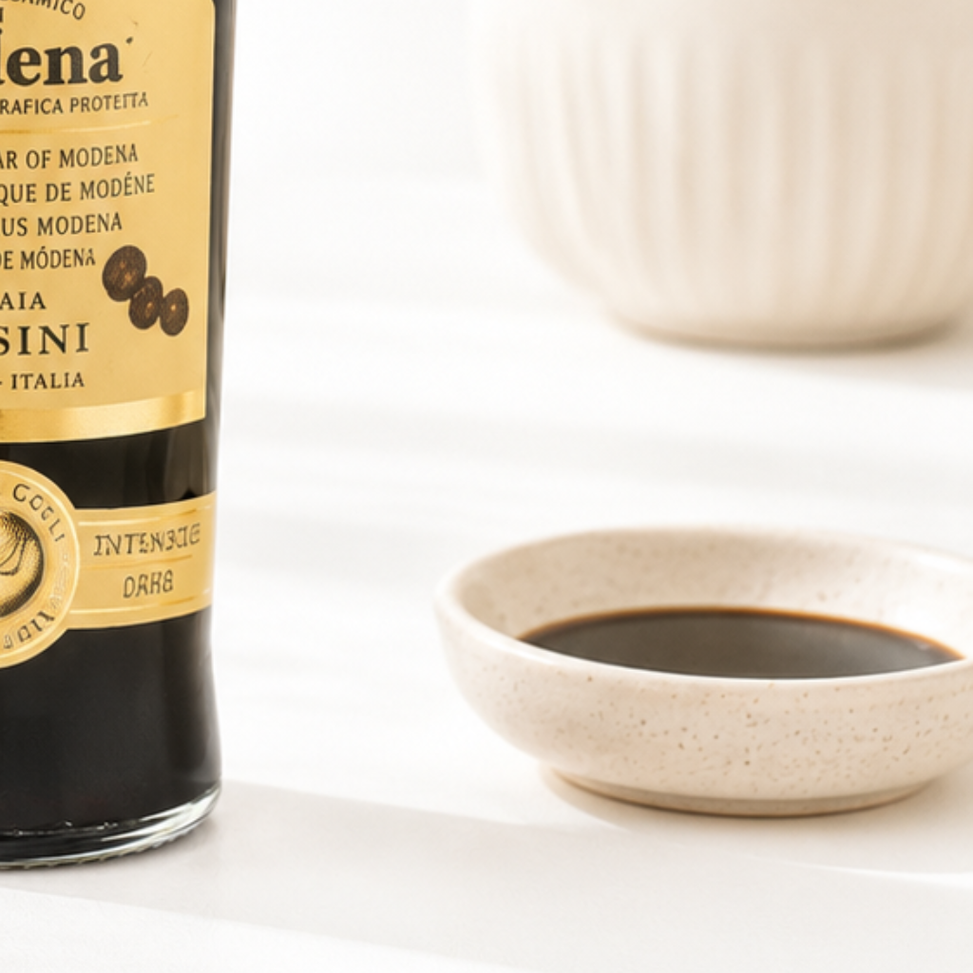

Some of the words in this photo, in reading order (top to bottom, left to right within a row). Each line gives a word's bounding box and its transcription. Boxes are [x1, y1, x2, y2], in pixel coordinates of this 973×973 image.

[26, 149, 52, 169] OF
[59, 143, 139, 168] MODENA
[46, 182, 72, 202] DE
[37, 211, 123, 236] MODENA
[20, 245, 96, 270] MÓDENA
[11, 371, 85, 390] ITALIA
